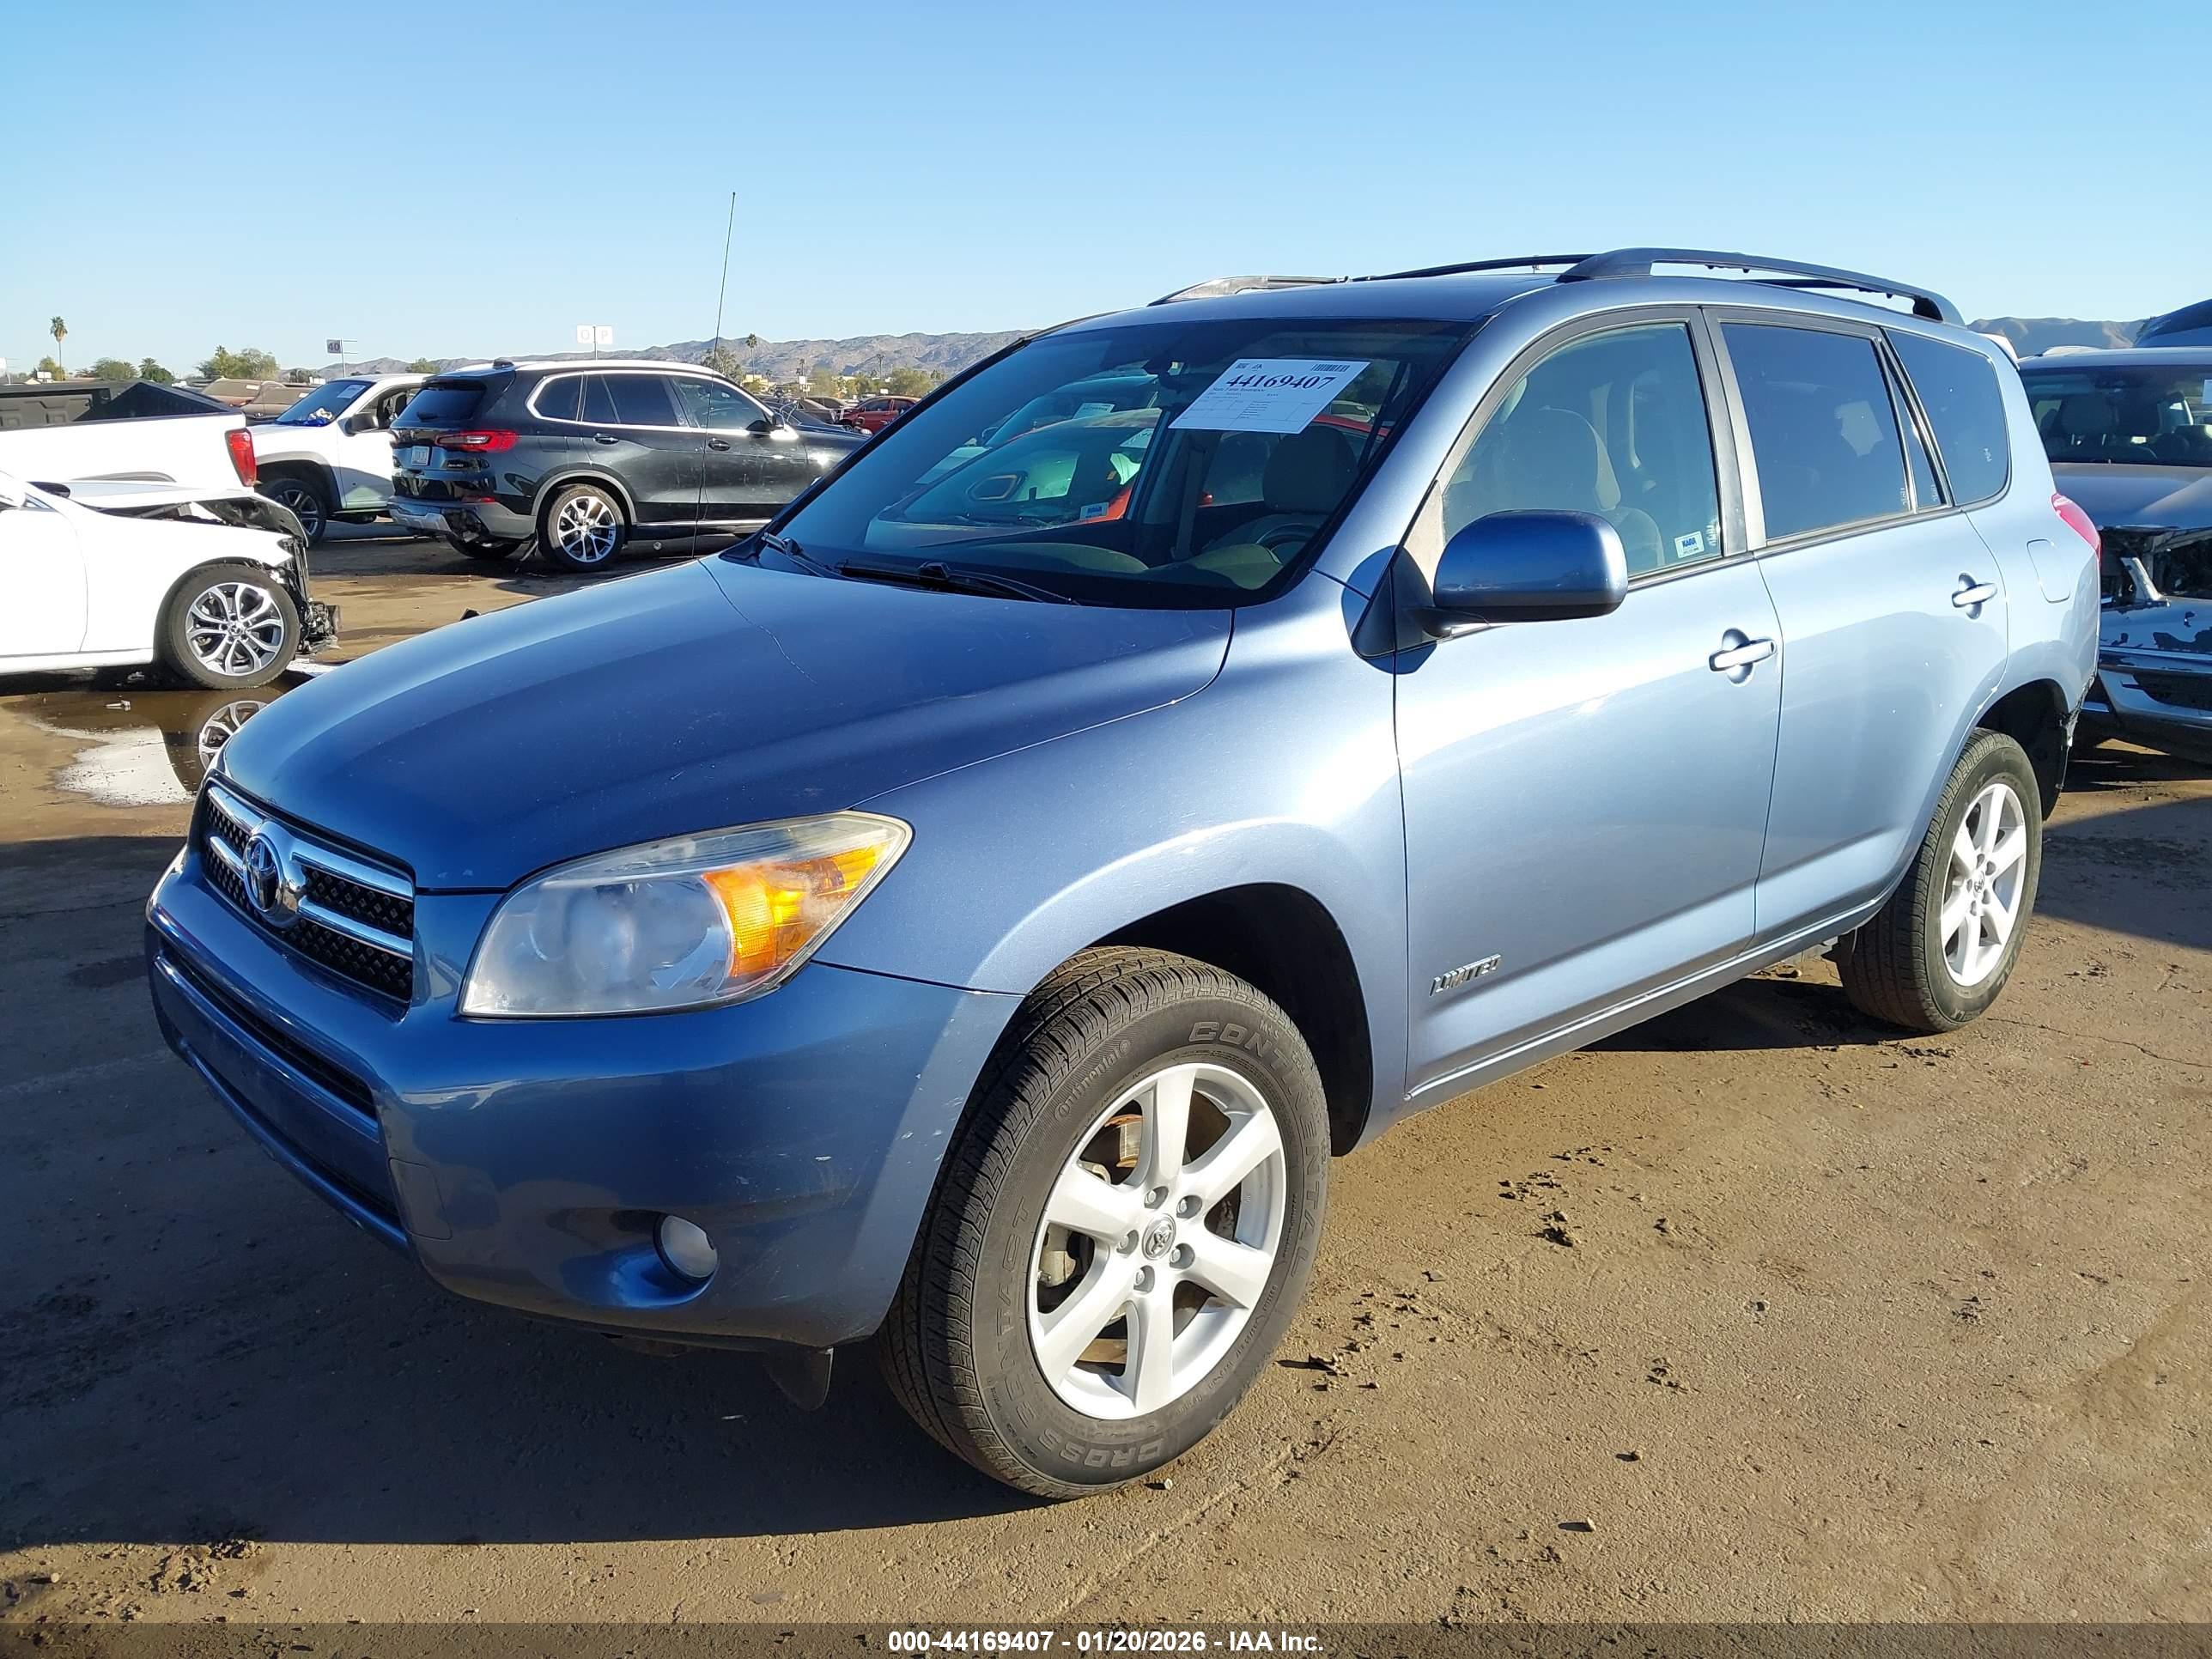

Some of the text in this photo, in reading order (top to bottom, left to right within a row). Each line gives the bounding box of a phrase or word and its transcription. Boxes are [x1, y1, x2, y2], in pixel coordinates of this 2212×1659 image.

[328, 343, 341, 351] 40
[1226, 374, 1336, 389] 44169407
[1429, 953, 1502, 997] LIMITED
